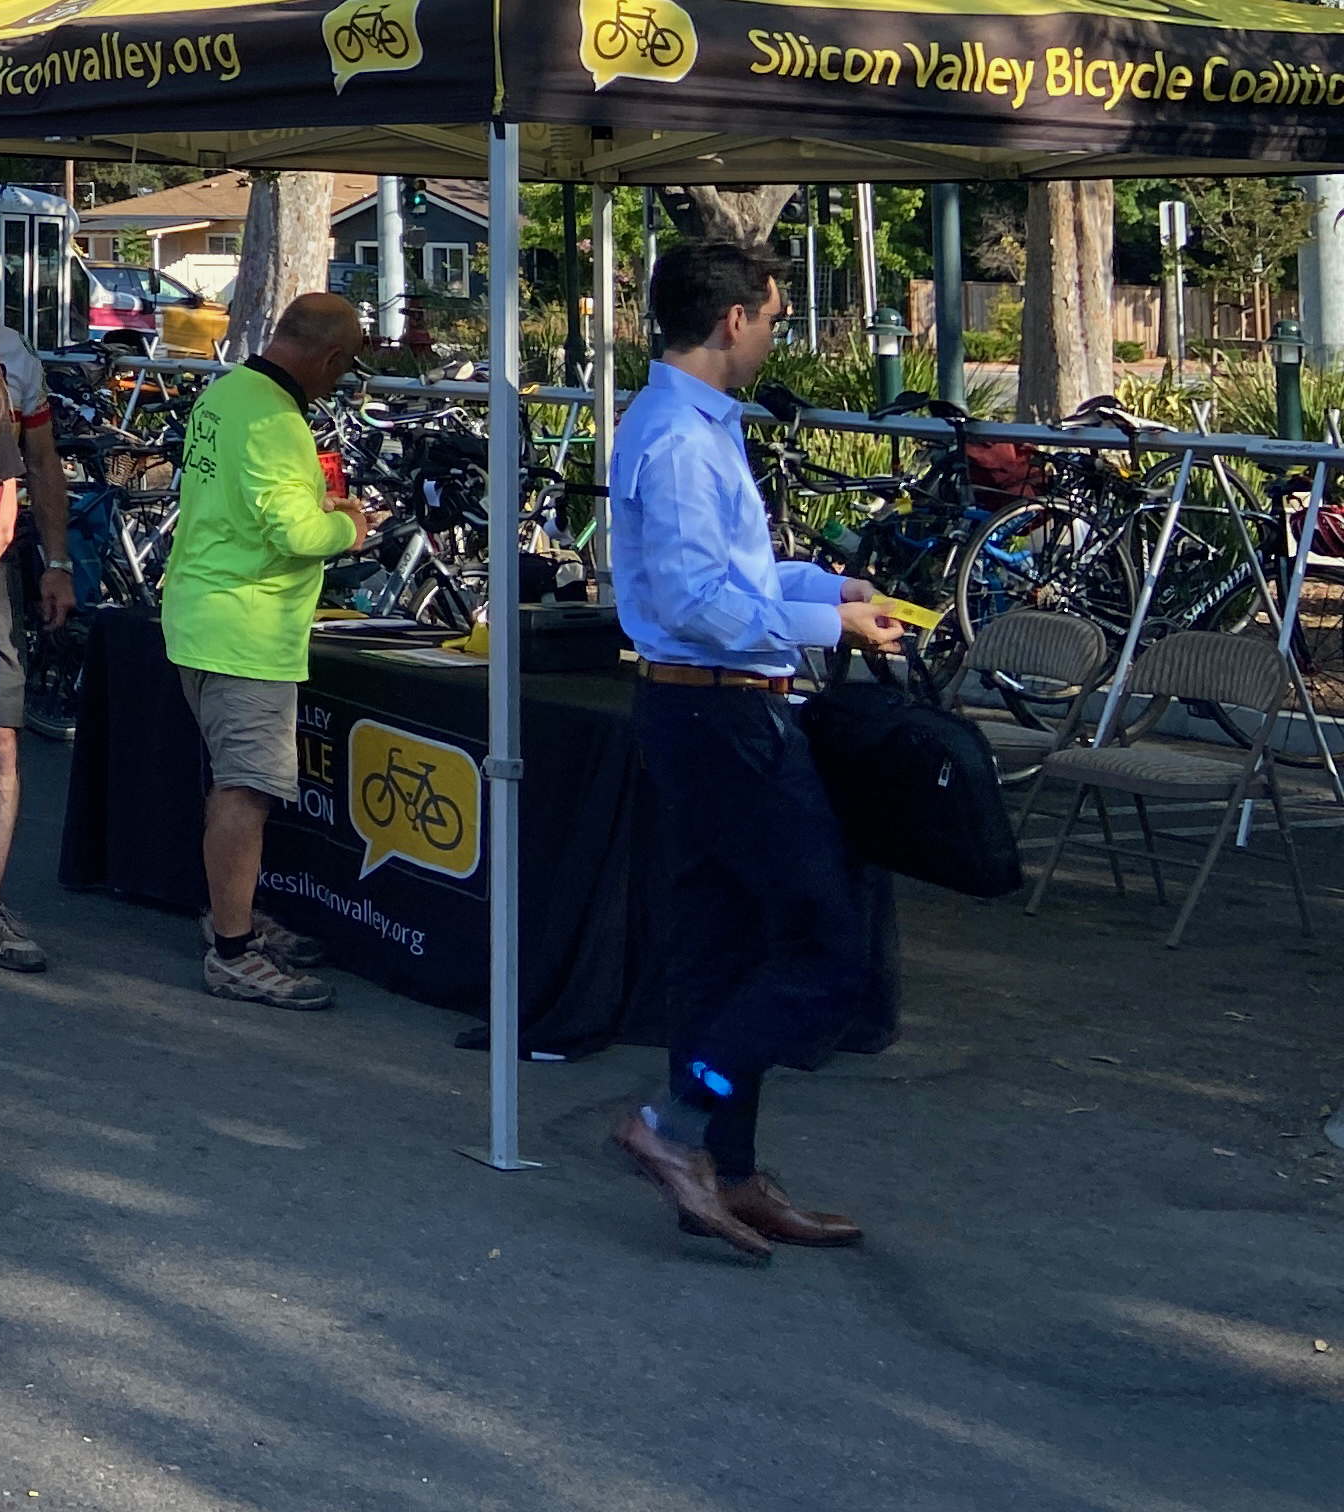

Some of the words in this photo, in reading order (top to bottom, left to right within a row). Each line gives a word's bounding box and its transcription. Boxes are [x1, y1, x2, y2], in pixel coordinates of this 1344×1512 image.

[747, 28, 901, 86] Silicon
[902, 41, 1034, 109] Valley
[1045, 47, 1193, 110] Bicycle
